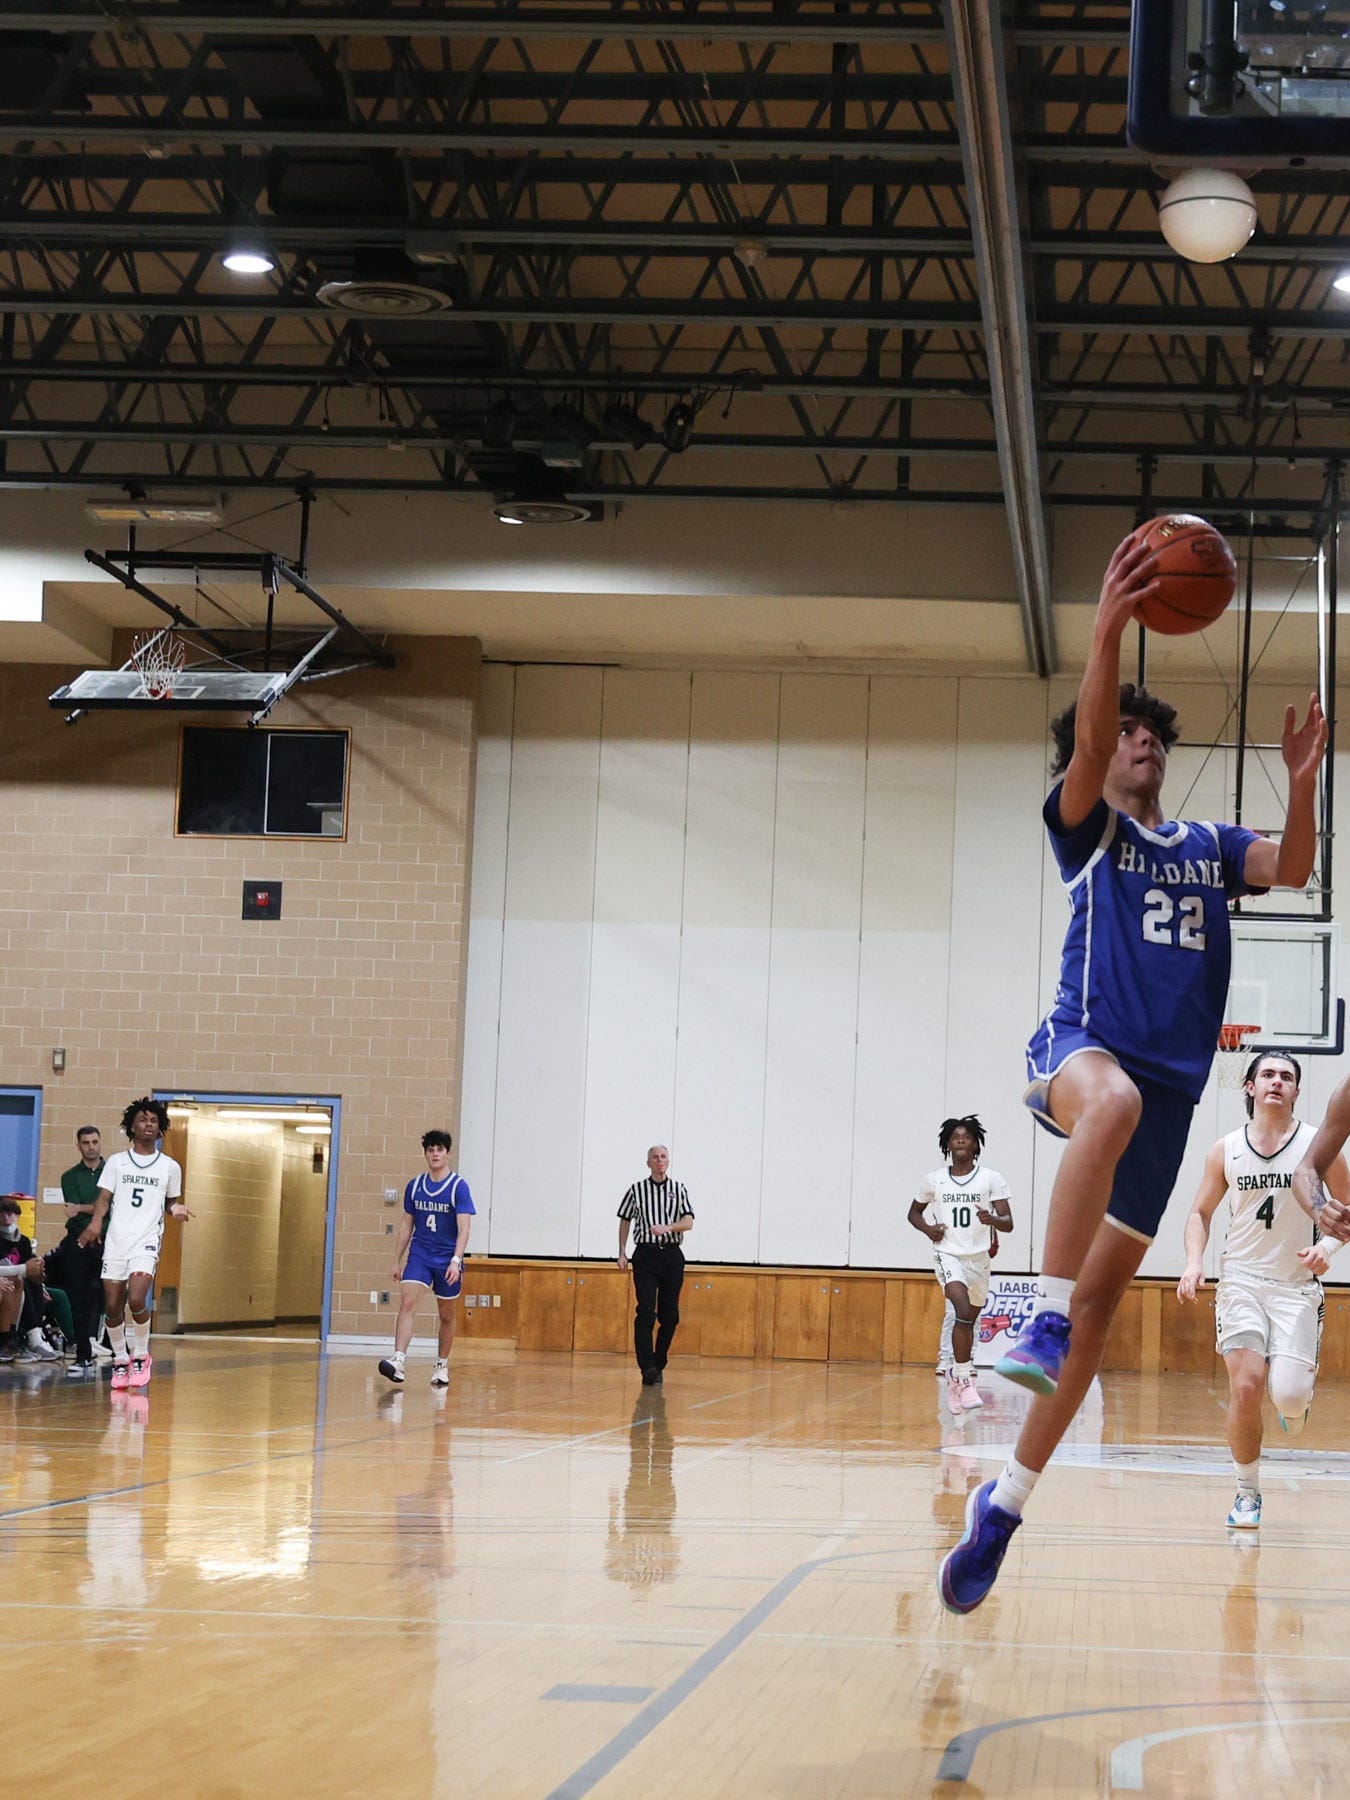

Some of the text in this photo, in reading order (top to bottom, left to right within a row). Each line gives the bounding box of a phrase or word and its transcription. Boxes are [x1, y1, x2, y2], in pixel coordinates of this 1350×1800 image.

[1143, 889, 1206, 951] 22
[122, 1174, 159, 1187] SPARTANS
[1237, 1173, 1292, 1191] SPARTAN
[131, 1188, 144, 1207] 5
[415, 1200, 450, 1213] HALDANE
[943, 1193, 981, 1203] SPARTANS
[952, 1207, 971, 1228] 10
[1256, 1195, 1274, 1229] 4
[426, 1214, 437, 1233] 4
